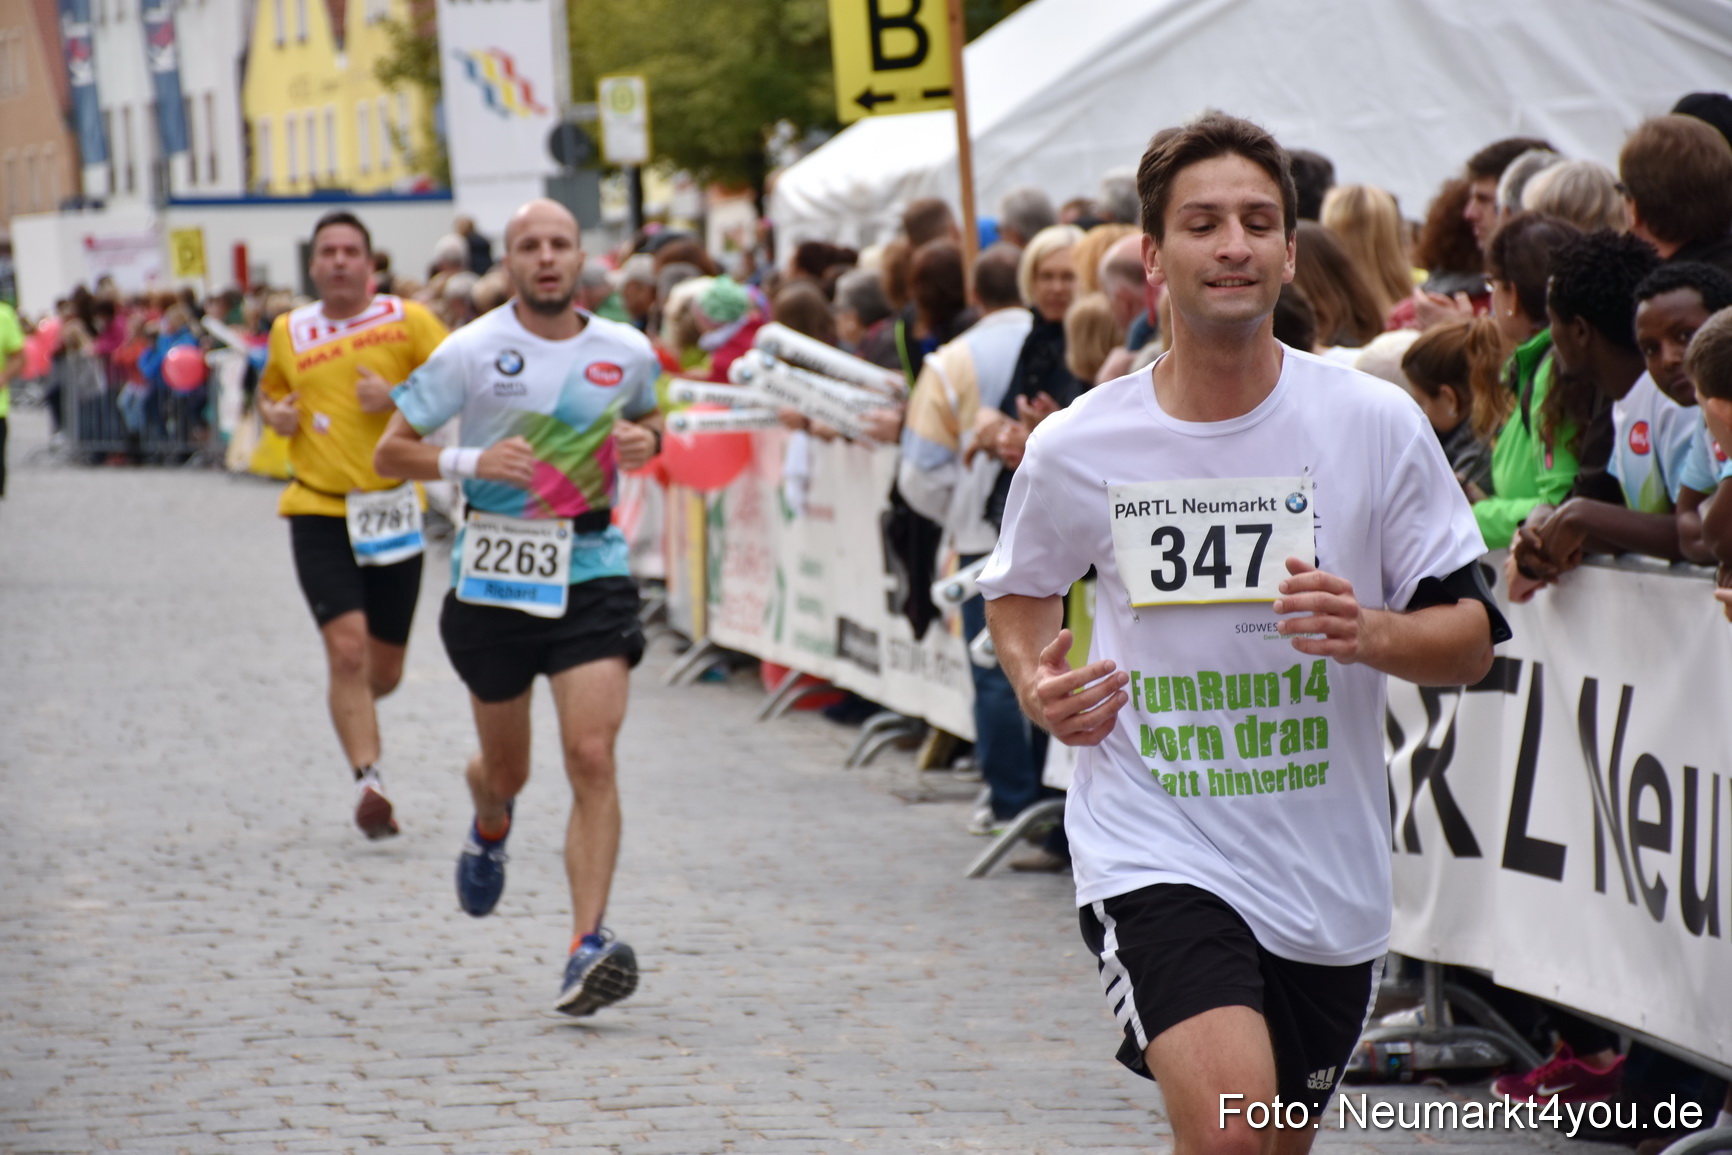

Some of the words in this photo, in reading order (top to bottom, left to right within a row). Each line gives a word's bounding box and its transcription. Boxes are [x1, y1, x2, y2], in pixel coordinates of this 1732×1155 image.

[867, 0, 930, 71] B
[1114, 499, 1177, 519] PARTL
[1182, 496, 1277, 515] Neumarkt
[473, 536, 558, 577] 2263
[1150, 523, 1273, 592] 347
[485, 582, 538, 601] Richard
[1131, 658, 1330, 714] FunRun14
[1234, 714, 1329, 760] dran
[1207, 760, 1330, 797] hinterher
[1578, 676, 1732, 943] Neu
